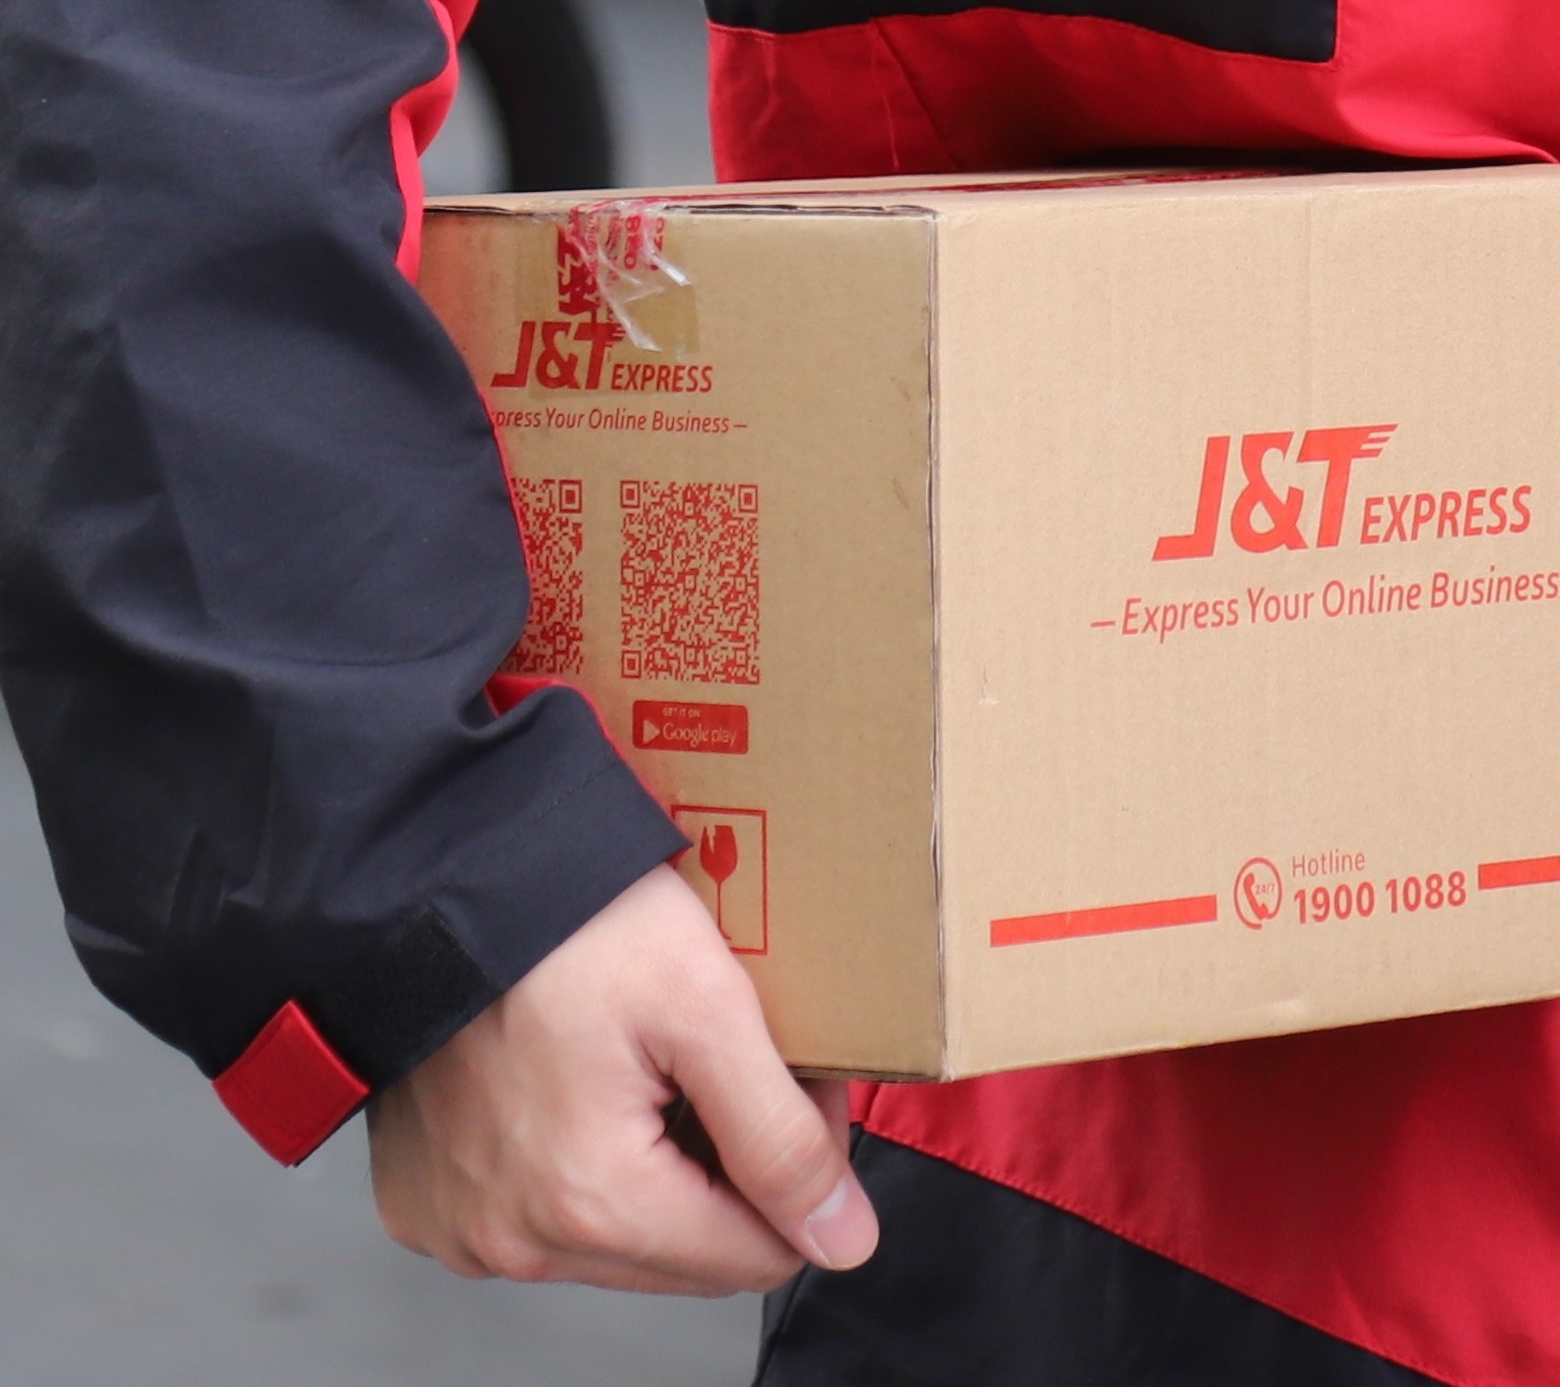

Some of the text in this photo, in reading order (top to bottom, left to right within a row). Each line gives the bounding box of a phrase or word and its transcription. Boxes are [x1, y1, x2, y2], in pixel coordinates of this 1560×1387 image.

[490, 320, 714, 393] J&T EXPRESS
[546, 407, 585, 429] Your
[590, 407, 647, 431] Online
[652, 409, 730, 434] Business
[1151, 423, 1533, 562] J&T EXPRESS
[1121, 564, 1560, 644] Express Your Online Business
[662, 722, 737, 747] Google play
[1292, 848, 1366, 878] Hotline
[1255, 883, 1276, 895] 24/7
[1294, 870, 1467, 925] 1900 1088
